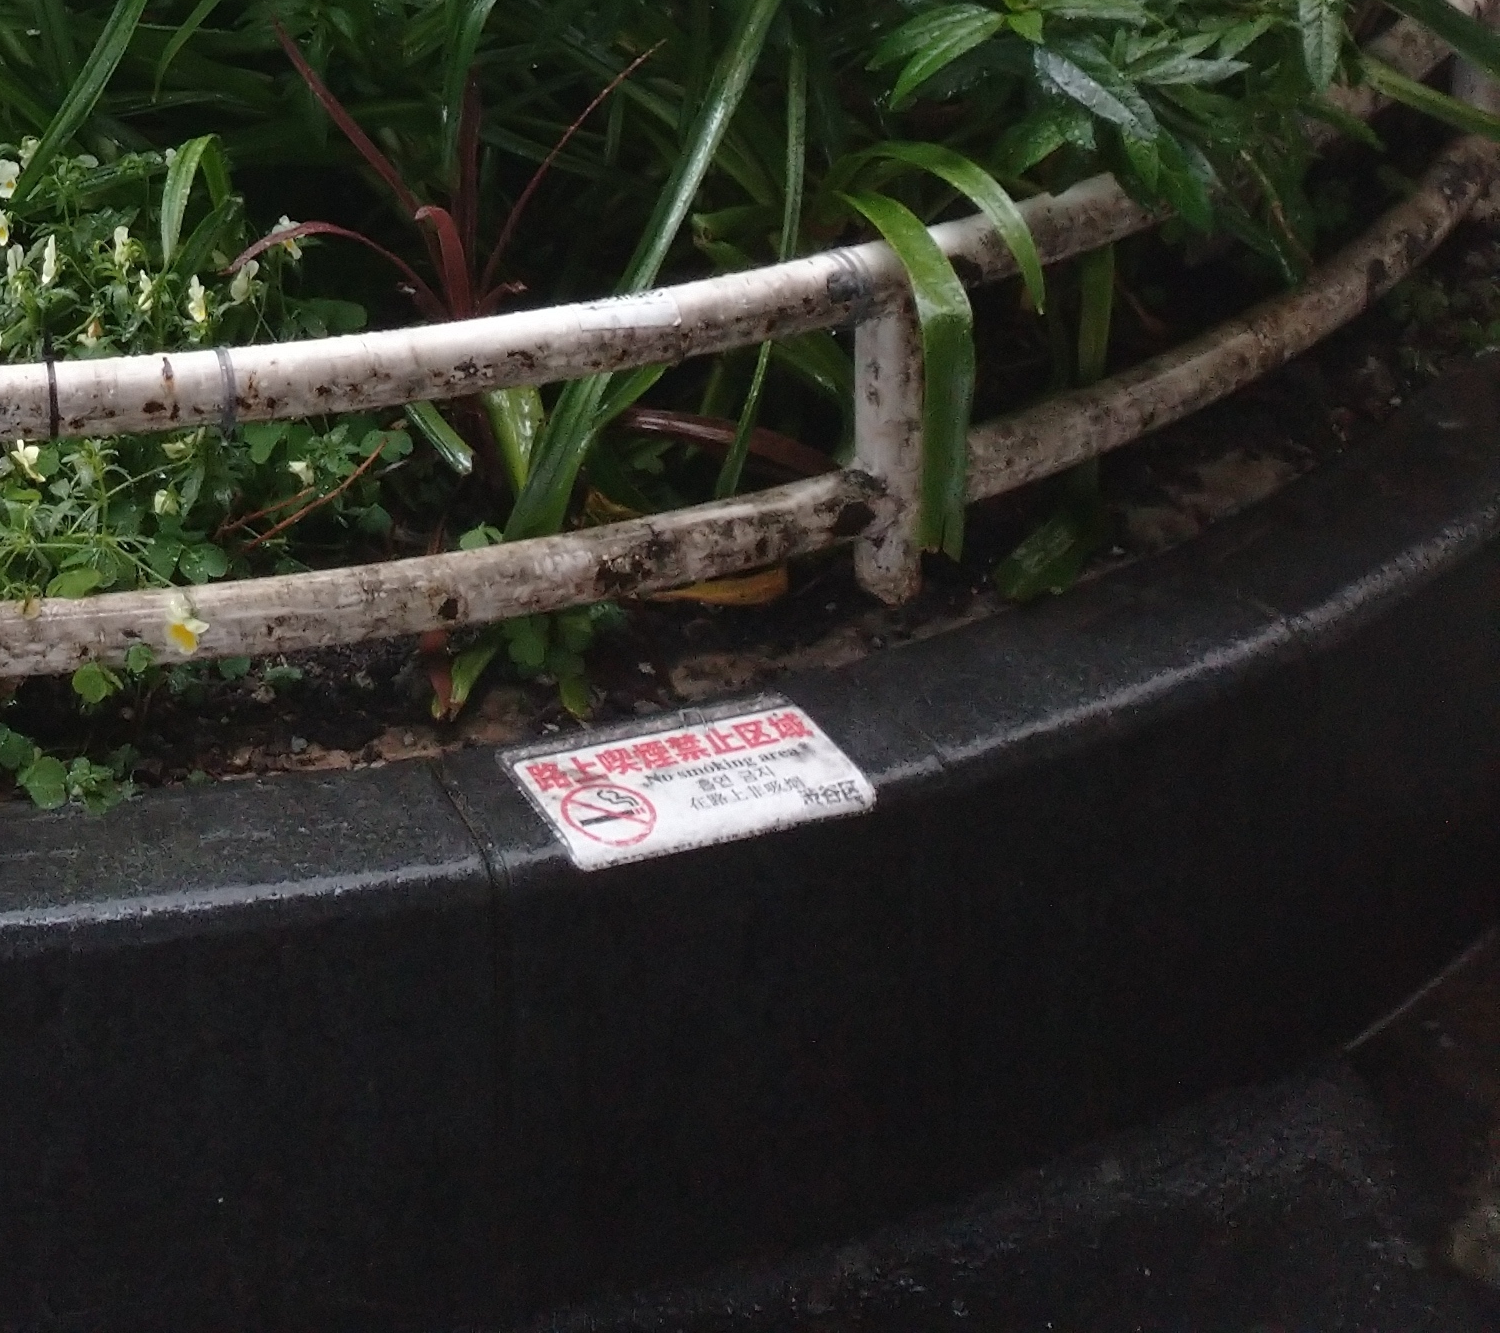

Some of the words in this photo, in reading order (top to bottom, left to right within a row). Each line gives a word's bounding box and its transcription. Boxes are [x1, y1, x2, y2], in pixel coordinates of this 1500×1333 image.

[526, 712, 814, 792] 路上喫煙禁止区域
[643, 771, 673, 787] No
[677, 755, 754, 780] smoking
[759, 747, 800, 762] area
